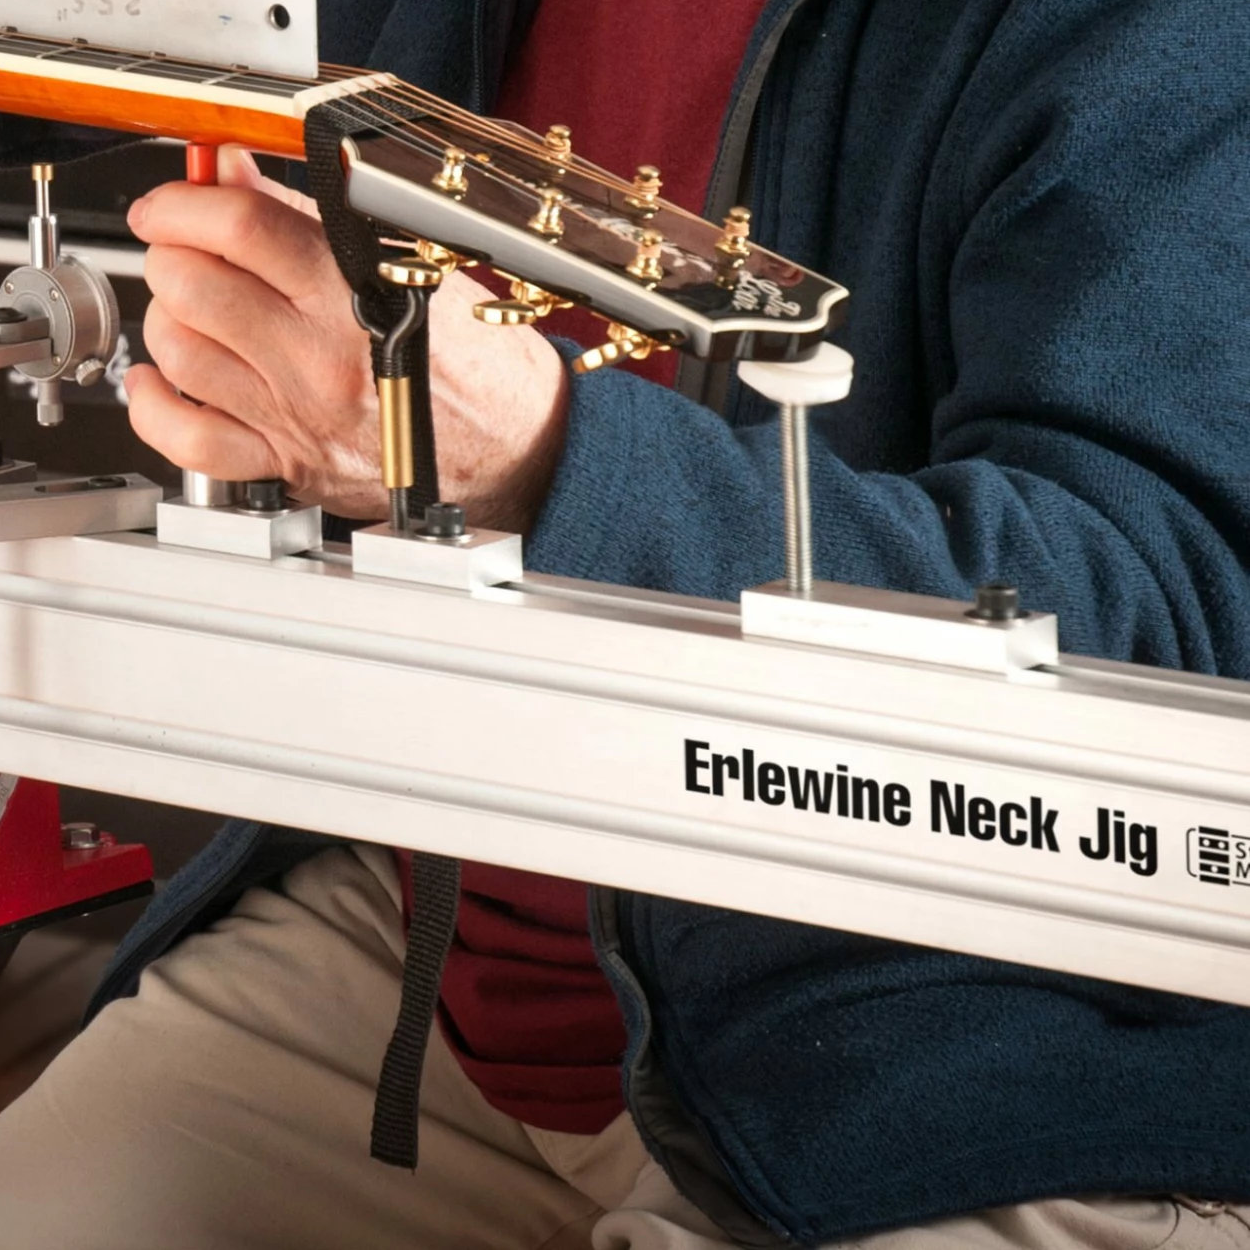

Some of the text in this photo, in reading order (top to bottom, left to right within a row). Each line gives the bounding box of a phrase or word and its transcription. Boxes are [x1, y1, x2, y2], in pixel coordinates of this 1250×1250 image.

[683, 738, 1158, 877] Erlewine Neck Jig
